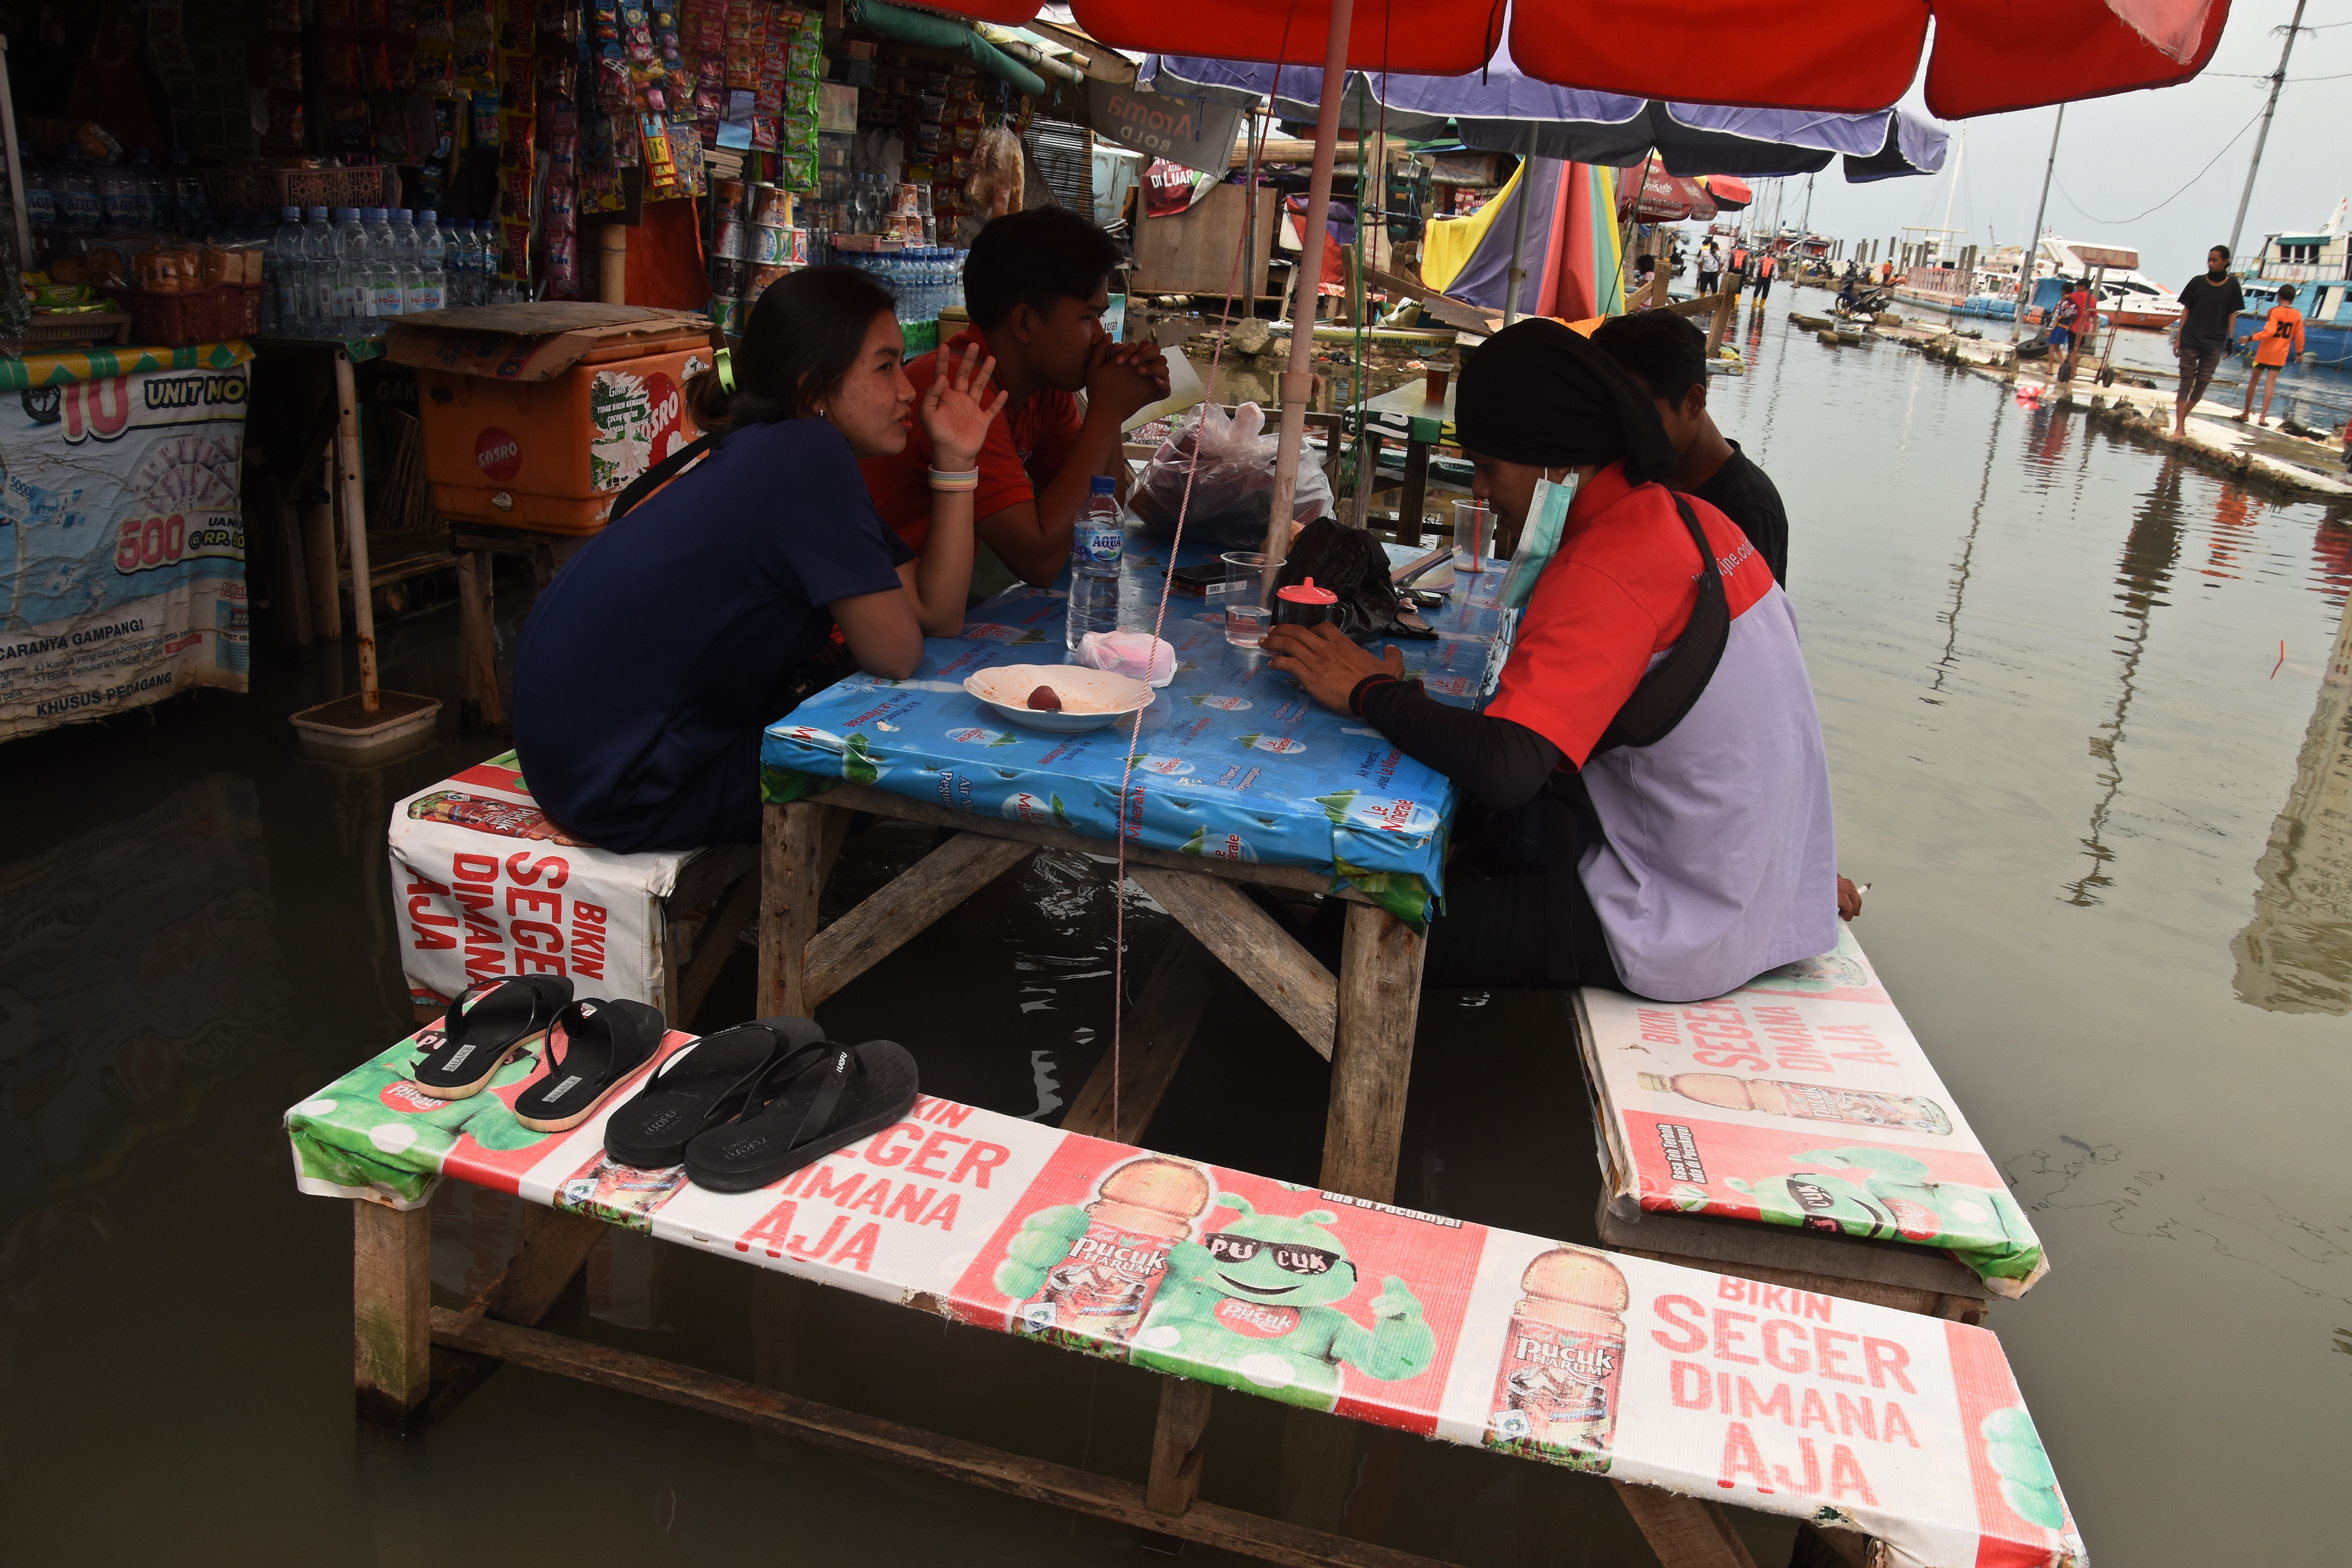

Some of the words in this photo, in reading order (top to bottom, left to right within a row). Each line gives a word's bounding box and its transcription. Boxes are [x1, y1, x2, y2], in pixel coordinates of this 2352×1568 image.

[553, 155, 572, 164] Klin
[1168, 164, 1182, 173] ATAU
[1151, 175, 1163, 189] DI
[1163, 169, 1194, 188] LUAR
[66, 196, 99, 211] AQUA
[550, 206, 570, 215] Klin
[549, 256, 569, 265] Klin
[1381, 337, 1402, 345] ANAK
[1406, 338, 1431, 346] HITAM
[2274, 322, 2293, 339] 20
[146, 379, 201, 407] UNIT
[640, 390, 679, 439] OSRO
[117, 513, 184, 569] 500
[1092, 536, 1121, 550] AQUA
[1692, 535, 1755, 585] w.jne.co.id
[72, 619, 144, 646] GAMPANG!
[46, 657, 75, 670] Kardus
[76, 653, 96, 665] yang
[98, 647, 121, 658] cacat
[121, 637, 163, 653] hologramnya
[48, 670, 71, 681] Batas
[72, 660, 113, 676] penukaran
[115, 653, 141, 666] hadiah
[142, 648, 163, 660] sampai
[36, 691, 103, 717] KHUSUS
[105, 672, 172, 701] PEDAGANG
[1429, 679, 1450, 688] Le
[1445, 676, 1469, 697] Minerale
[843, 707, 883, 728] Minerale
[877, 702, 891, 710] Le
[1271, 737, 1293, 754] Minerale
[1156, 757, 1182, 775] Minerale
[1221, 765, 1242, 780] Mineral
[1361, 751, 1382, 771] Mineral,
[1375, 766, 1394, 776] Le
[959, 775, 972, 796] Air
[1214, 775, 1230, 787] Air
[1233, 767, 1262, 791] Pegunungan
[1355, 770, 1371, 778] Air
[1374, 775, 1391, 790] Jelas
[489, 811, 517, 825] HARUM
[495, 807, 537, 831] pucuk
[1031, 811, 1045, 821] Le
[1127, 785, 1147, 841] Minerale
[1362, 805, 1389, 816] Le
[1380, 797, 1415, 833] Minerale
[405, 864, 459, 950] AJA
[505, 851, 570, 981] SEGE
[571, 900, 608, 982] BIKIN
[1637, 1008, 1681, 1045] BIKIN
[1751, 1006, 1835, 1073] DIMANA
[1817, 1025, 1900, 1066] AJA
[446, 1045, 473, 1071] BALANCE
[835, 1051, 848, 1074] LUOFU
[397, 1091, 436, 1109] HARUM
[544, 1076, 578, 1102] BALANCE
[907, 1093, 974, 1129] KIN
[1796, 1086, 1843, 1119] pucuk
[1656, 1124, 1677, 1147] Terbaik
[1674, 1125, 1700, 1159] Pucuknya!
[834, 1122, 1010, 1190] GER
[1665, 1147, 1681, 1161] Teh
[1686, 1158, 1700, 1168] di
[1672, 1162, 1689, 1181] Rasa
[1689, 1169, 1706, 1183] ada
[762, 1162, 960, 1232] IMANA
[1321, 1191, 1352, 1205] ada
[1356, 1198, 1372, 1209] di
[1375, 1202, 1462, 1229] Pucuknya!
[734, 1200, 882, 1272] AJA
[1068, 1236, 1167, 1270] pucuk
[1083, 1252, 1151, 1275] HARUM
[1717, 1274, 1833, 1323] BIKIN
[1221, 1303, 1293, 1329] pucuk
[1515, 1336, 1615, 1370] pucuk
[1650, 1293, 1918, 1395] SEGER
[1532, 1353, 1603, 1376] HARUM
[1669, 1360, 1920, 1449] DIMANA
[1716, 1422, 1879, 1506] AJA
